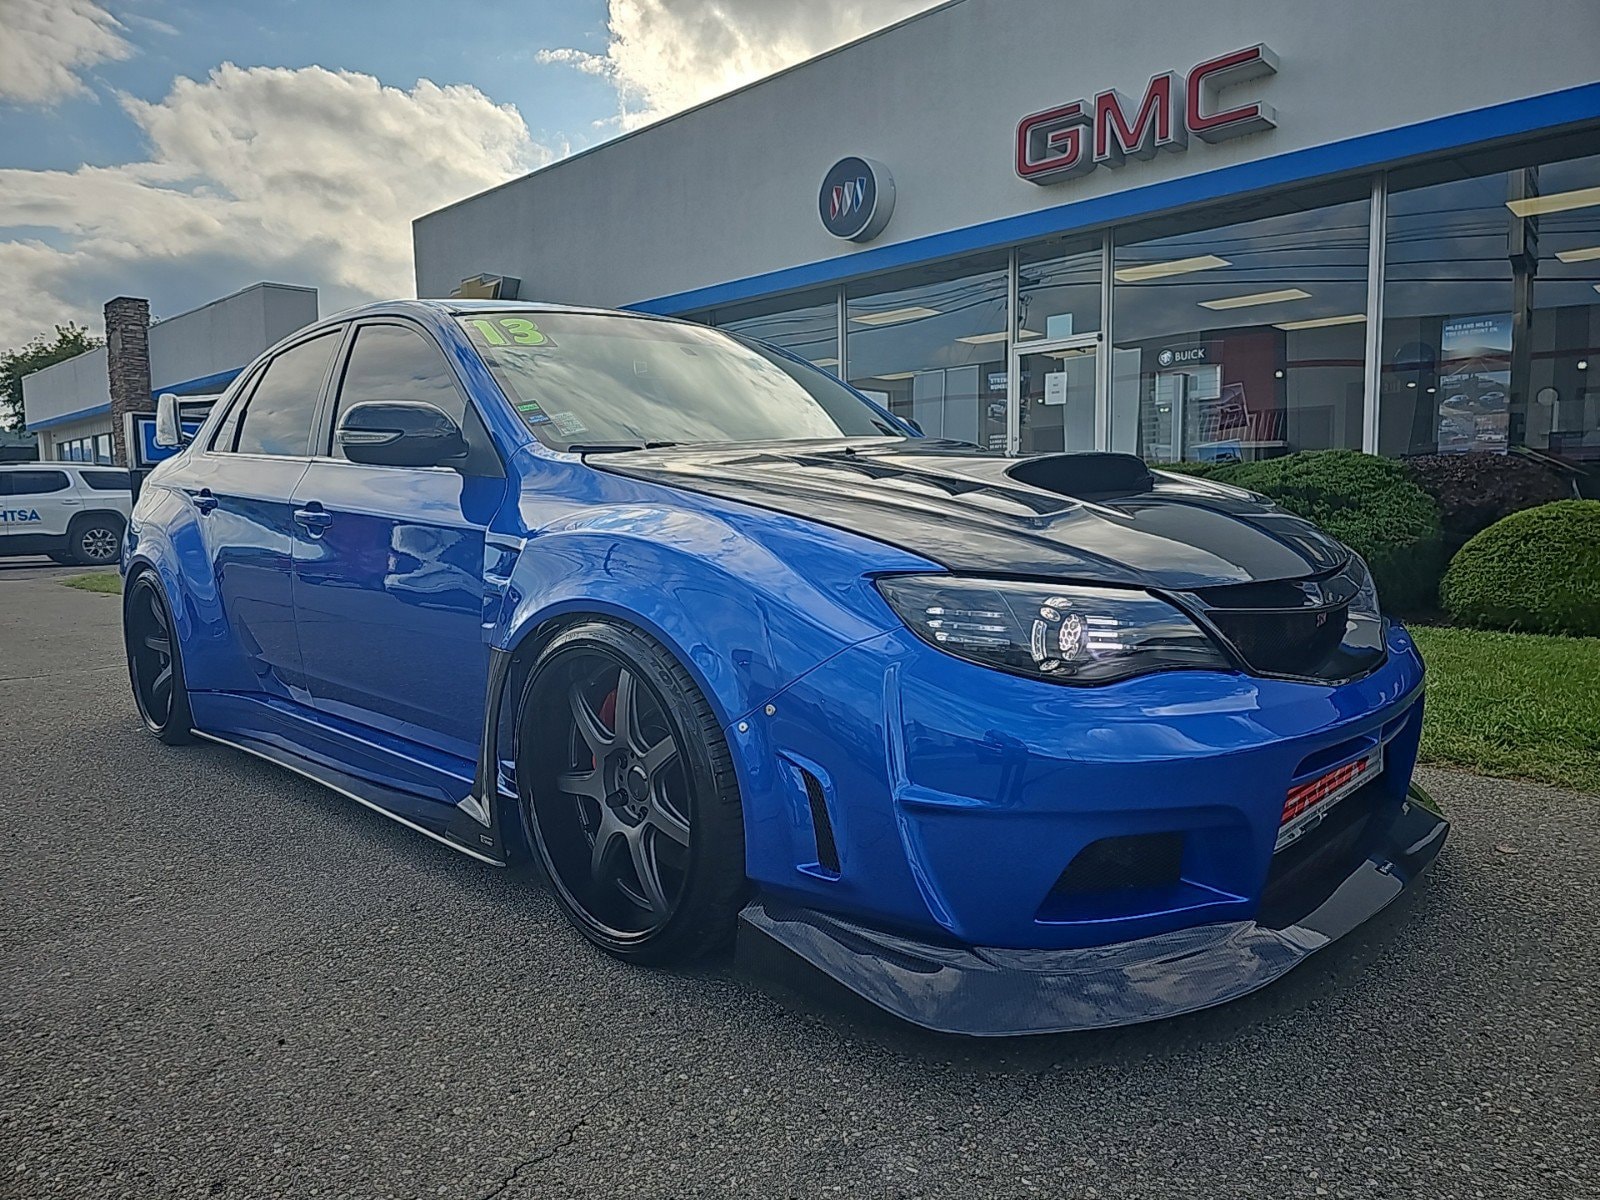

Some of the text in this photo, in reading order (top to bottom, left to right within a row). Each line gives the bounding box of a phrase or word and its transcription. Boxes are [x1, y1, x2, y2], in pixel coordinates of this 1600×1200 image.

[1015, 42, 1266, 178] GMC
[472, 318, 548, 346] 13
[1174, 348, 1205, 362] BUICK
